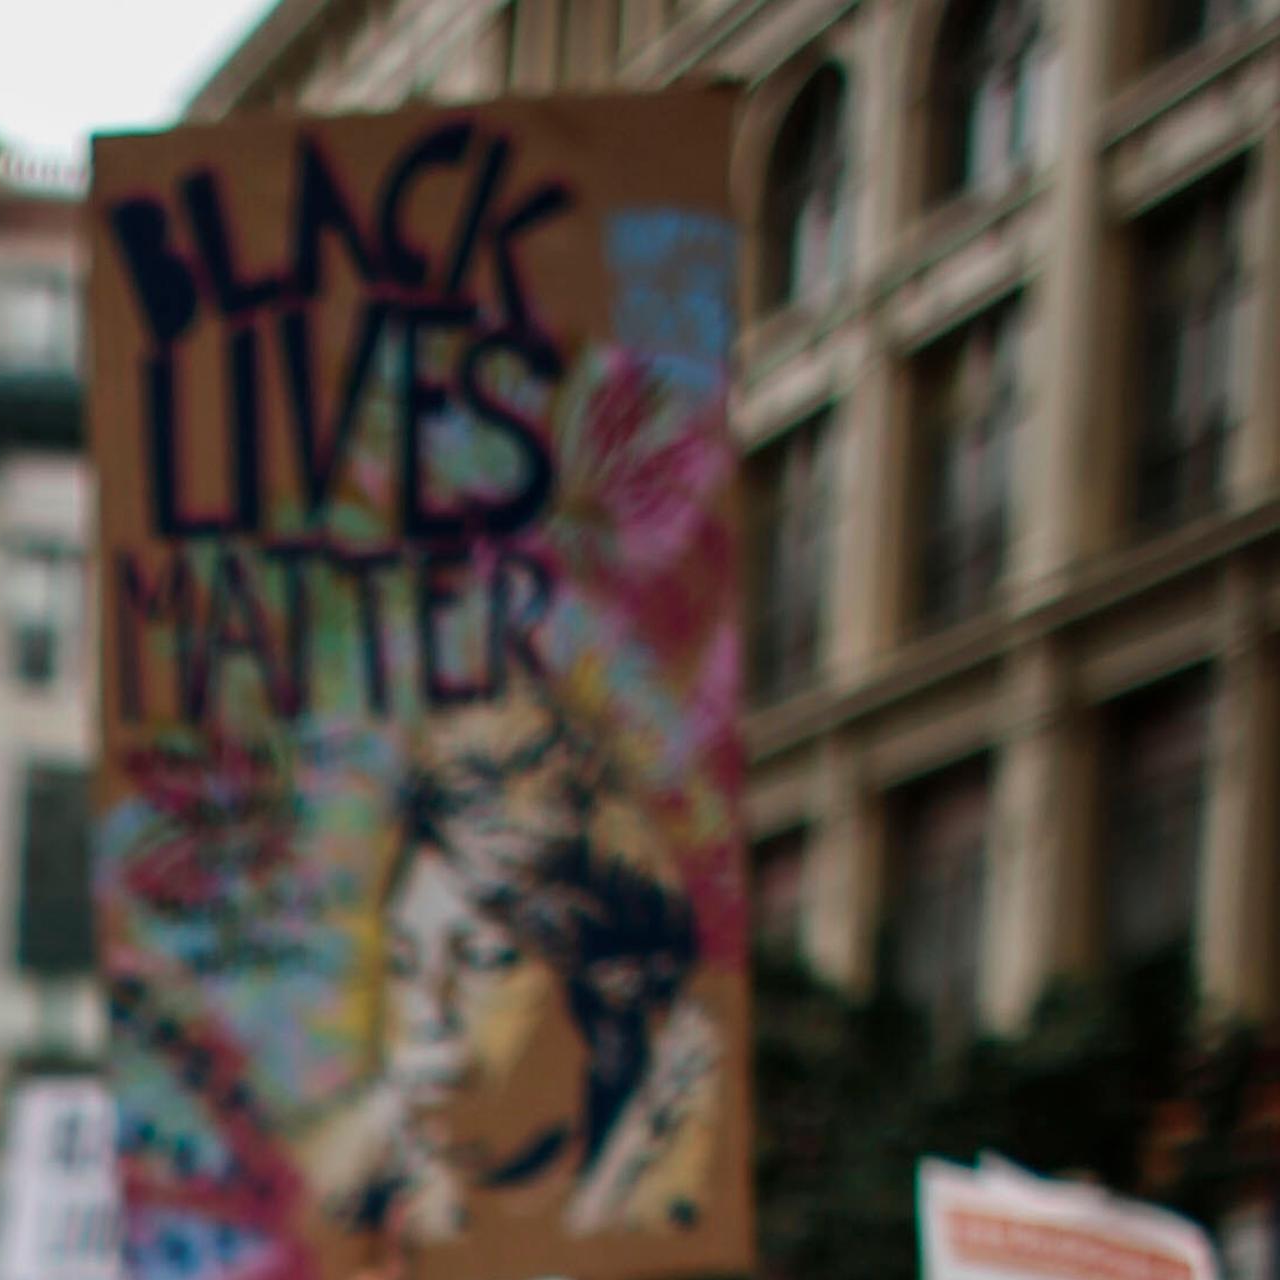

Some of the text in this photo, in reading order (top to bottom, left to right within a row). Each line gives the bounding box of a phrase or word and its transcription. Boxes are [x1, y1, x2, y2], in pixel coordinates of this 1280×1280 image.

[108, 118, 578, 378] BLACK
[145, 300, 558, 540] LIVES
[116, 538, 555, 725] MATTER
